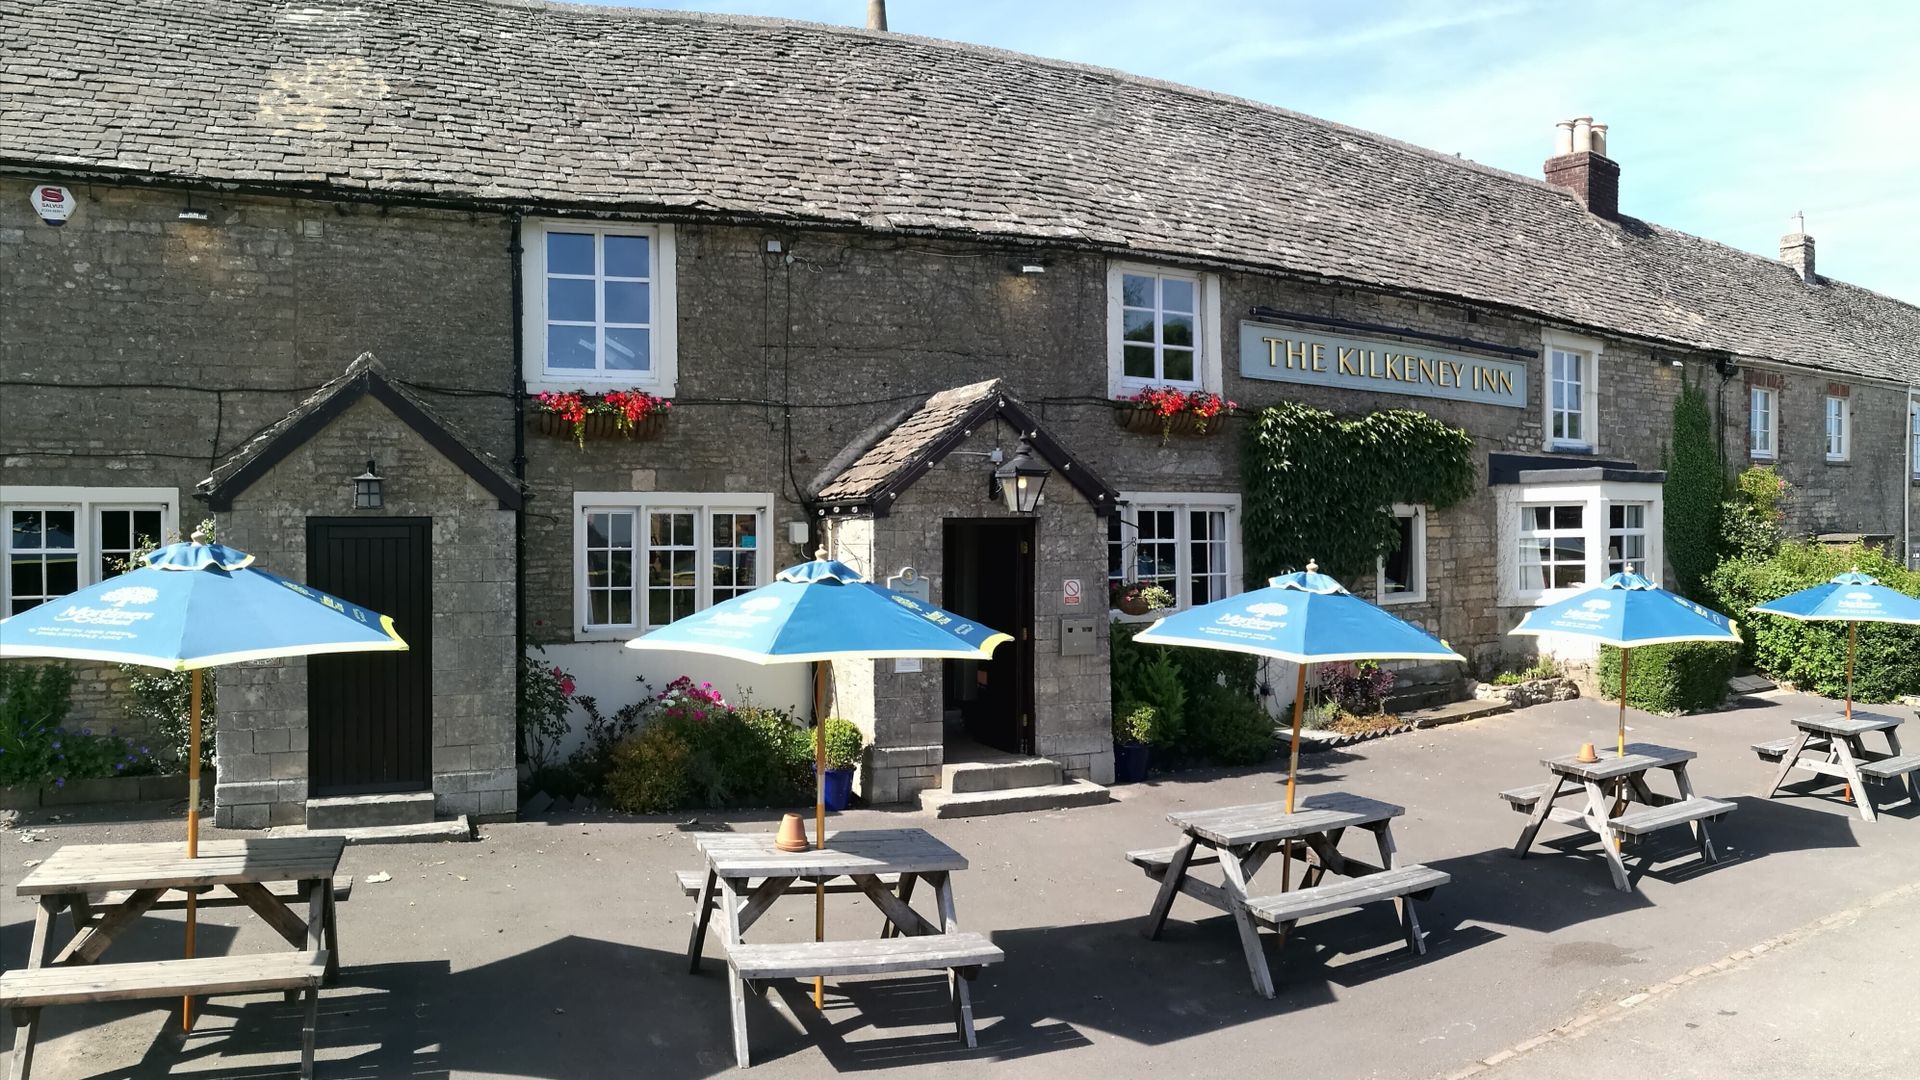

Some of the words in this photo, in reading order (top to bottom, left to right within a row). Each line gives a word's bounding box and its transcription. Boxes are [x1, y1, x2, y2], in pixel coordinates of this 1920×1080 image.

[1262, 336, 1328, 372] THE
[1337, 345, 1465, 389] KILKENEY
[1473, 365, 1513, 396] INN
